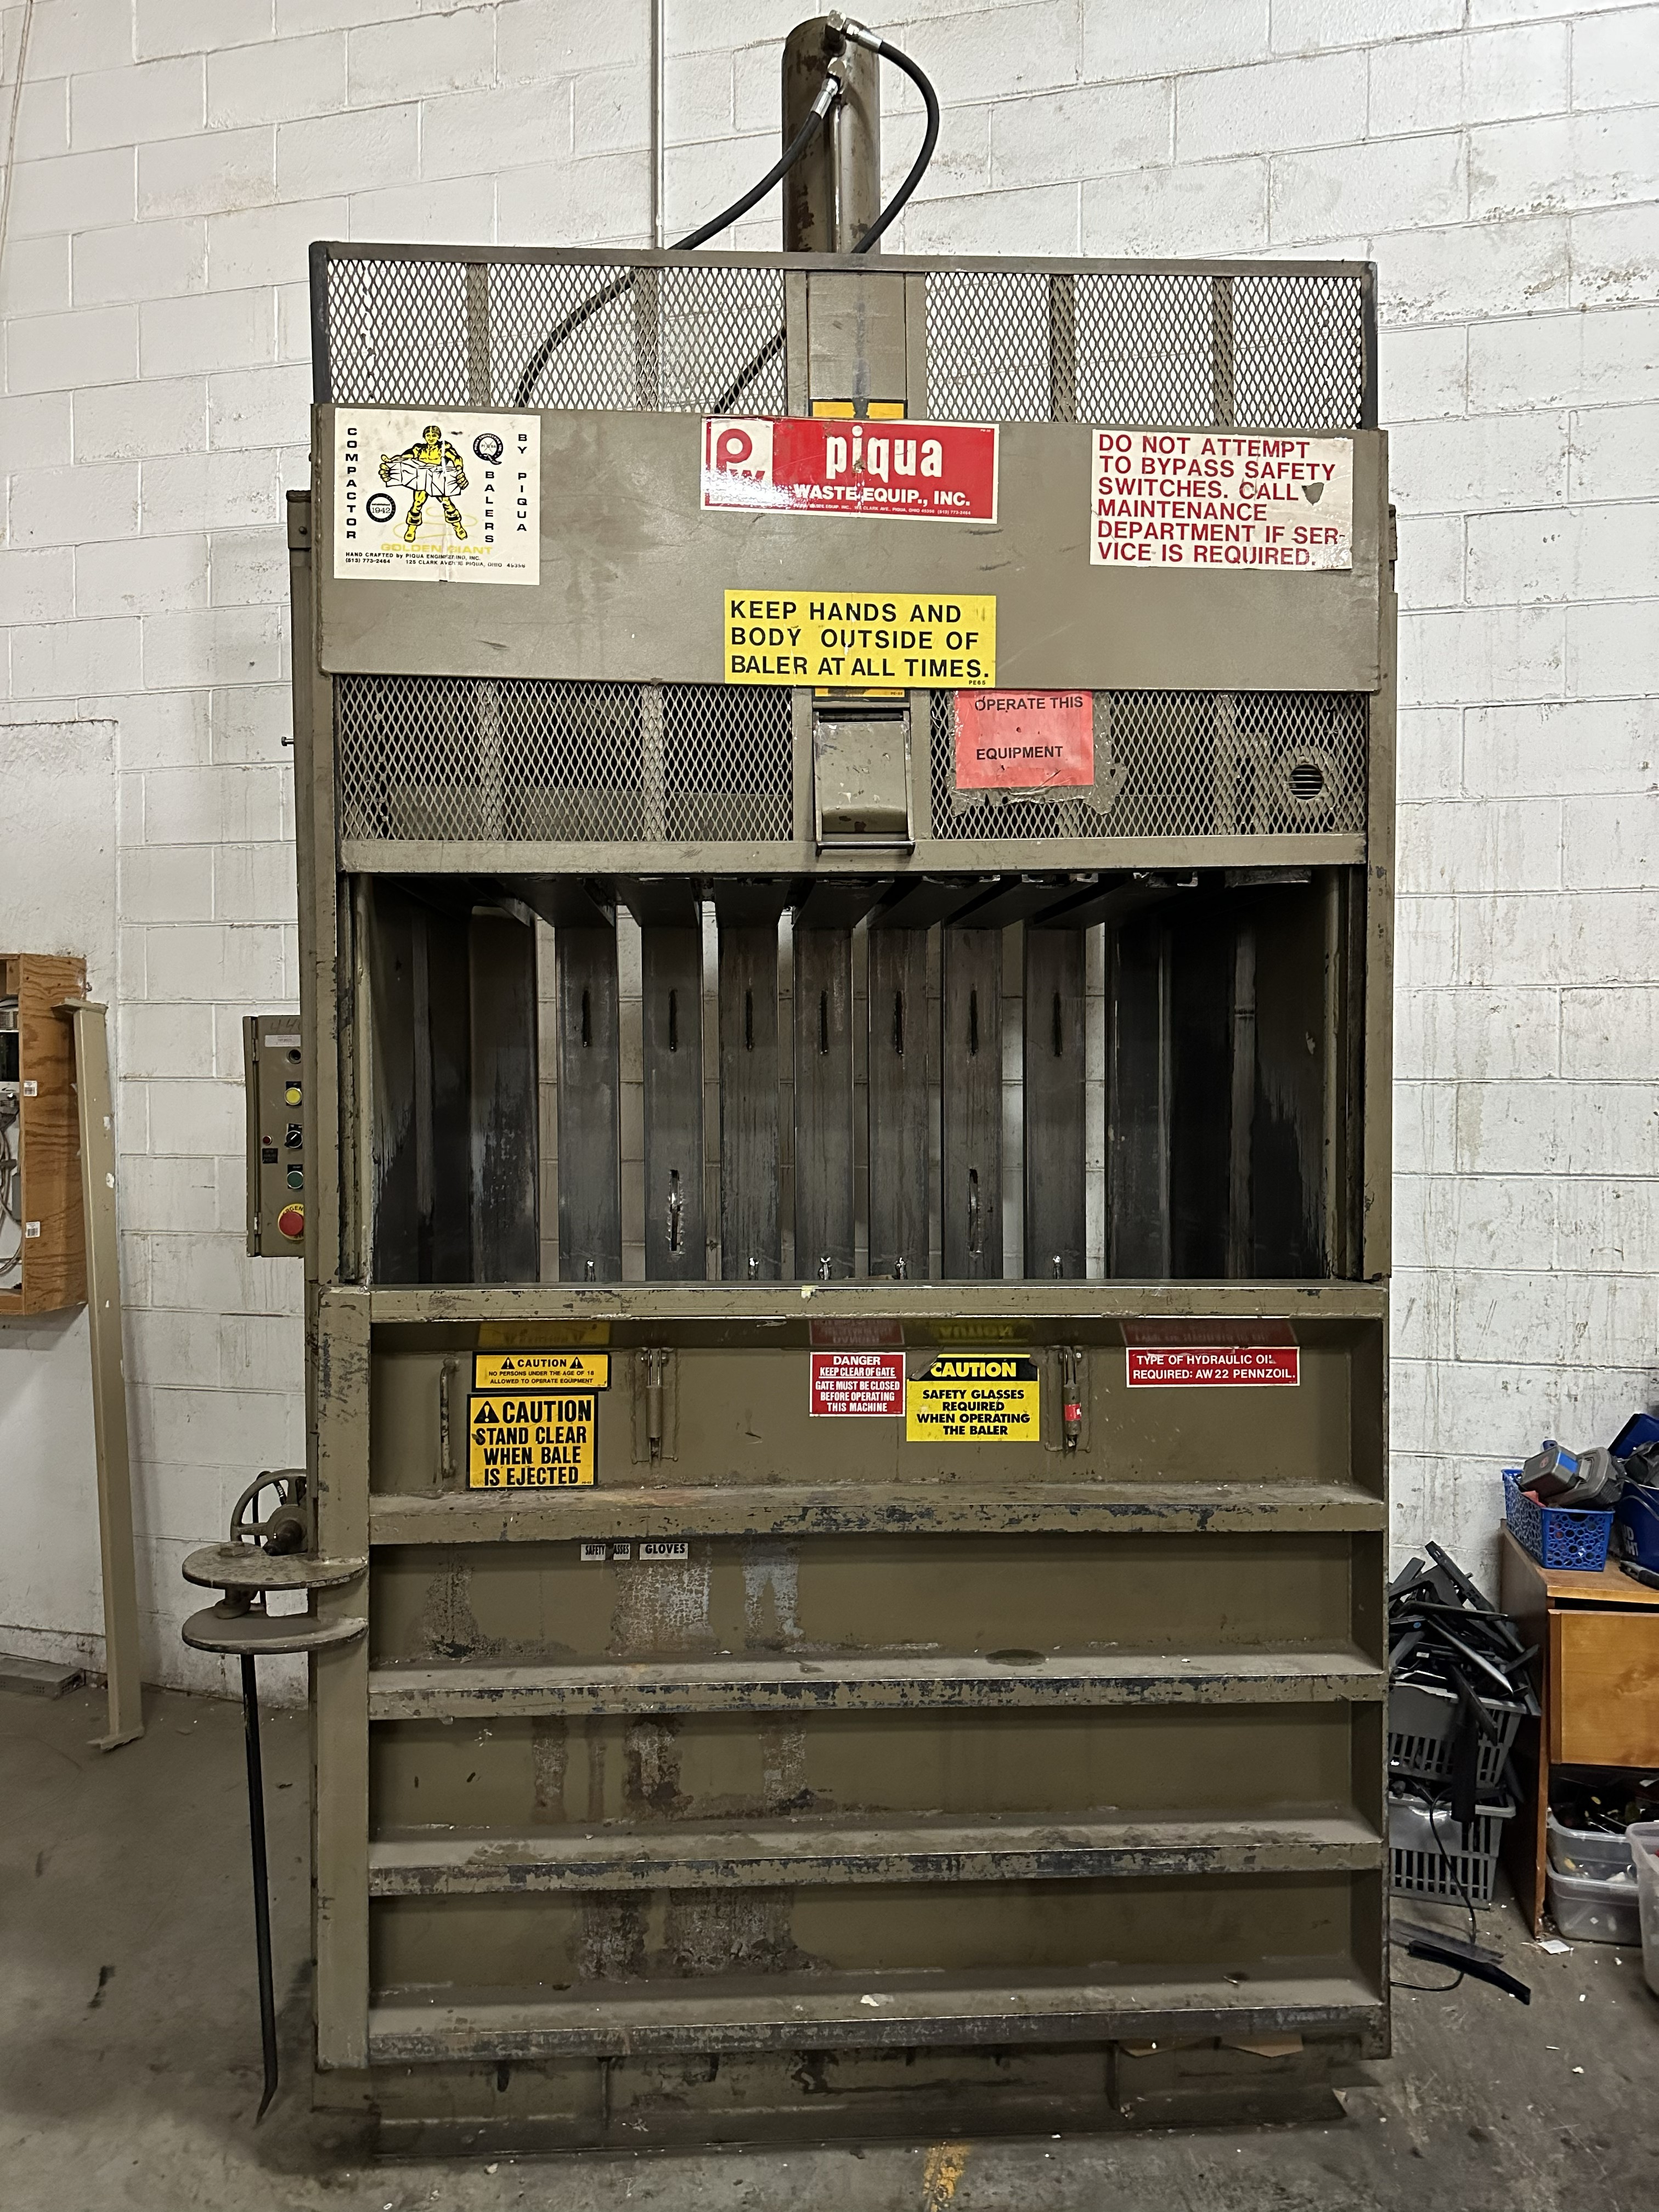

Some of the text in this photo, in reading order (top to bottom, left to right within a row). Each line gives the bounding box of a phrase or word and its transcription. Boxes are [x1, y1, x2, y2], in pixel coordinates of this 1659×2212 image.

[826, 425, 943, 483] piqua
[1099, 434, 1310, 459] DO NOT ATTEMPT
[1099, 456, 1335, 481] TO BYPASS SAFETY
[345, 427, 358, 539] COMPACTOR
[517, 434, 527, 532] BY PIQUA
[1098, 477, 1299, 500] SWITCHES. CALL
[794, 483, 970, 506] WASTE EQUIP., INC.
[484, 471, 495, 543] BALERS
[1098, 499, 1267, 521] MAINTENANCE
[1098, 521, 1345, 545] DEPARTMENT IF SER-
[380, 543, 493, 555] GOLDEN GIANT
[1098, 542, 1316, 566] VICE IS REQUIRED.
[731, 600, 961, 623] KEEP HANDS AND
[731, 627, 979, 650] BODY OUTSIDE OF
[731, 655, 989, 678] BALER AT ALL TIMES.
[975, 696, 1084, 711] OPERATE THIS
[977, 746, 1063, 760] EQUIPMENT
[517, 1359, 567, 1368] CAUTION
[833, 1356, 881, 1365] DANGER
[1136, 1355, 1276, 1365] TYPE OF HYDRAULIC OIL
[820, 1367, 895, 1376] KEEP CLEAR OF GATE
[930, 1362, 1016, 1377] CAUTION
[1133, 1369, 1296, 1379] REQUIRED: AW 22 PENNZOIL.
[815, 1381, 900, 1390] GATE MUST BE CLOSED
[820, 1392, 895, 1401] BEFORE OPERATING
[923, 1390, 1024, 1399] SAFETY GLASSES
[502, 1400, 591, 1424] CAUTION
[827, 1402, 888, 1412] THIS MACHINE
[943, 1402, 1005, 1412] REQUIRED
[917, 1413, 1030, 1423] WHEN OPERATING
[476, 1426, 587, 1446] STAND CLEAR
[943, 1426, 1008, 1435] THE BALER
[483, 1446, 581, 1465] WHEN BALE
[484, 1466, 578, 1486] IS EJECTED
[585, 1544, 629, 1555] SAFETY ASSES
[645, 1544, 685, 1554] GLOVES
